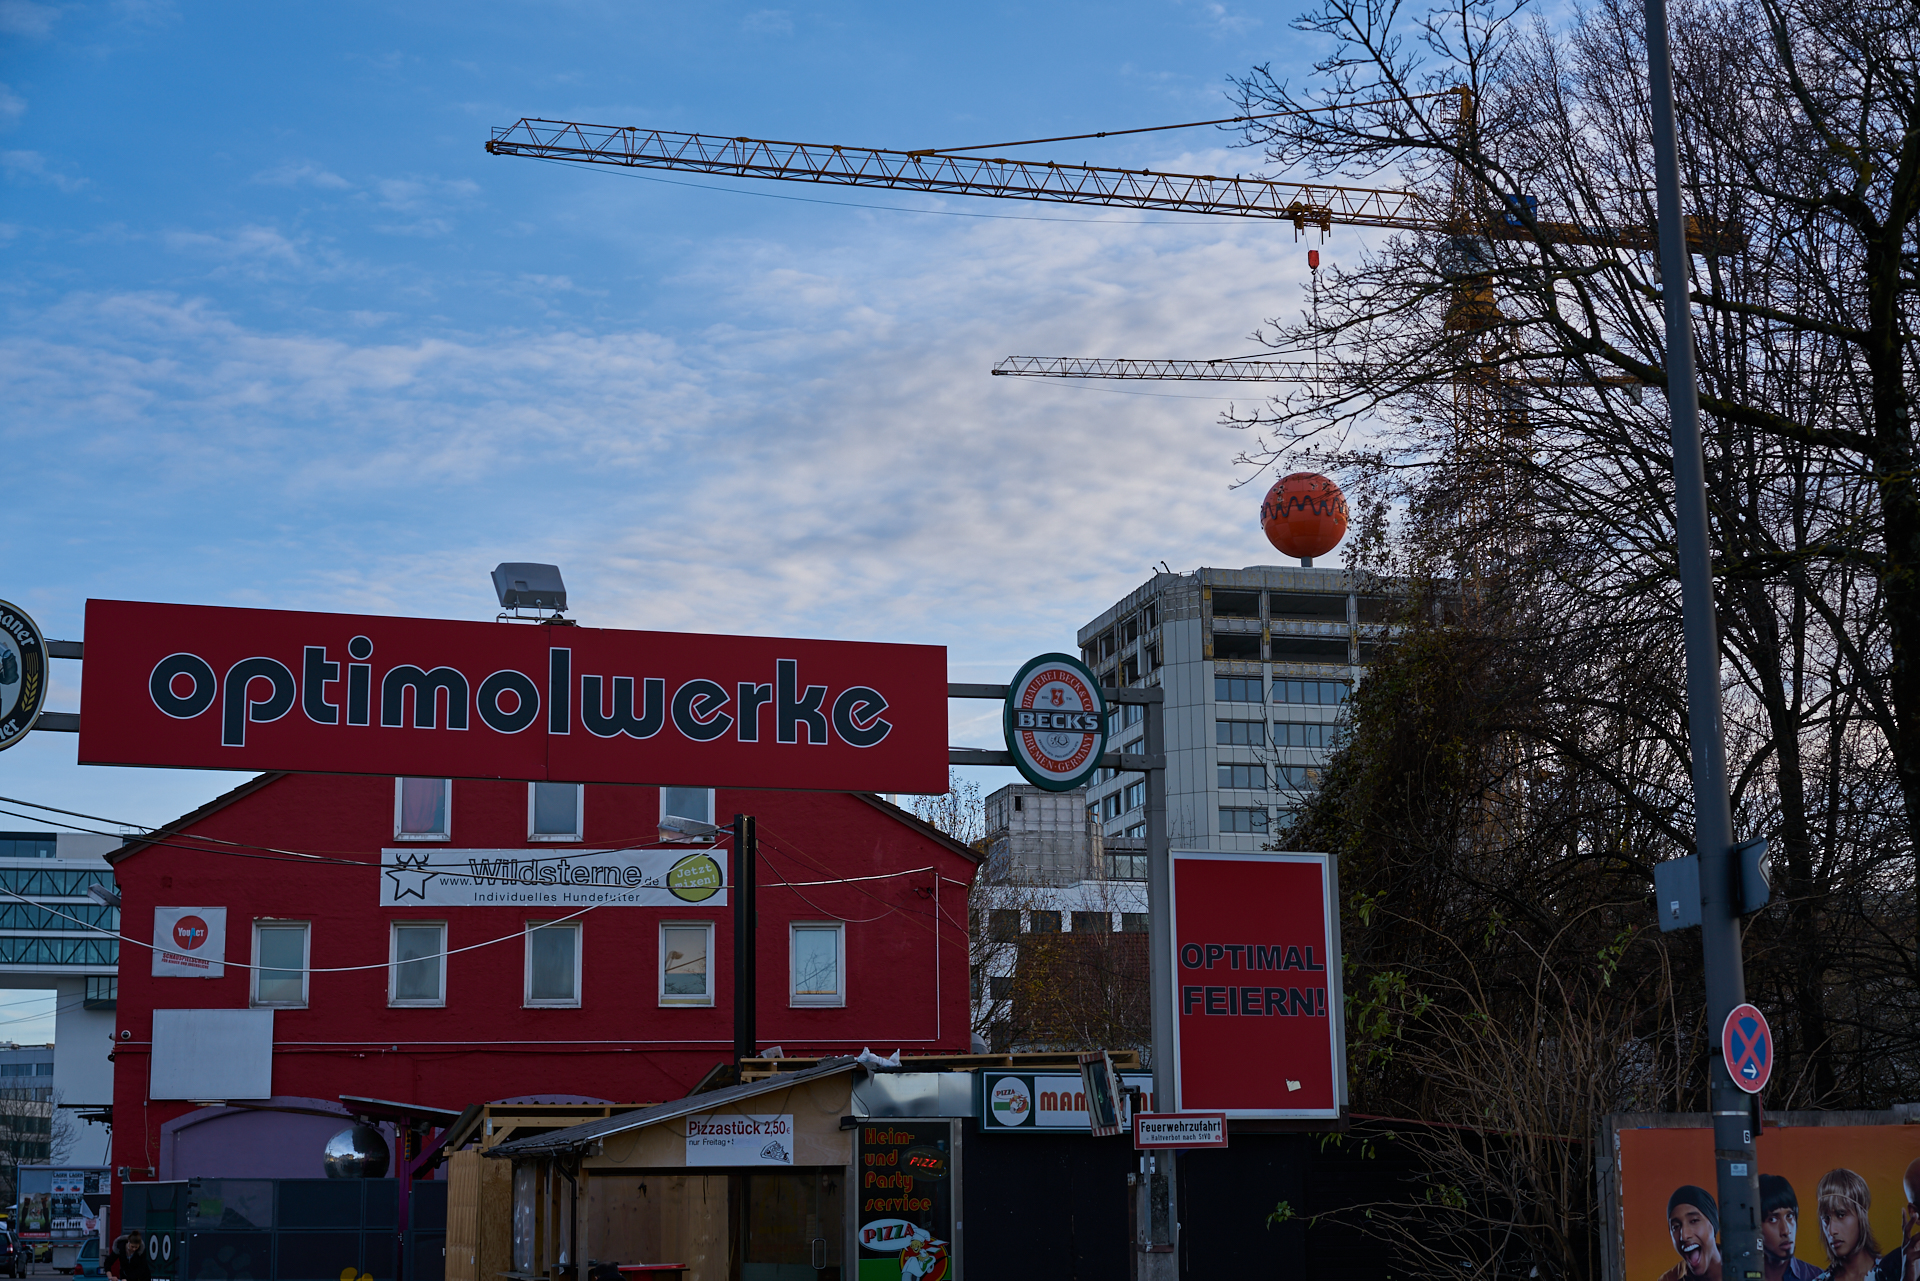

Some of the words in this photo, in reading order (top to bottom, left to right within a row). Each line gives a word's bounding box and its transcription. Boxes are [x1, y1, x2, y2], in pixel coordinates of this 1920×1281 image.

[148, 635, 893, 748] optimolwerke
[1023, 671, 1057, 709] BRAUEREI
[1059, 672, 1083, 691] BECK
[1018, 711, 1099, 731] BECK'S
[1023, 732, 1055, 770] BREMEN
[1058, 734, 1093, 771] GERMANY
[676, 863, 713, 879] Jetzt
[474, 892, 558, 902] Individuelles
[563, 892, 641, 902] Hundefutter
[1181, 943, 1325, 972] OPTIMAL
[1183, 986, 1326, 1017] FEIERN!
[996, 1089, 1015, 1097] PIZZA
[689, 1121, 761, 1135] Pizzastück
[864, 1126, 915, 1145] Heim-
[1141, 1120, 1221, 1133] Feuerwehrzufahrt
[703, 1138, 727, 1147] Freitag
[1182, 1132, 1197, 1140] nach
[864, 1149, 899, 1167] und
[864, 1171, 914, 1194] Party
[864, 1194, 932, 1212] service
[863, 1223, 915, 1244] PIZZA
